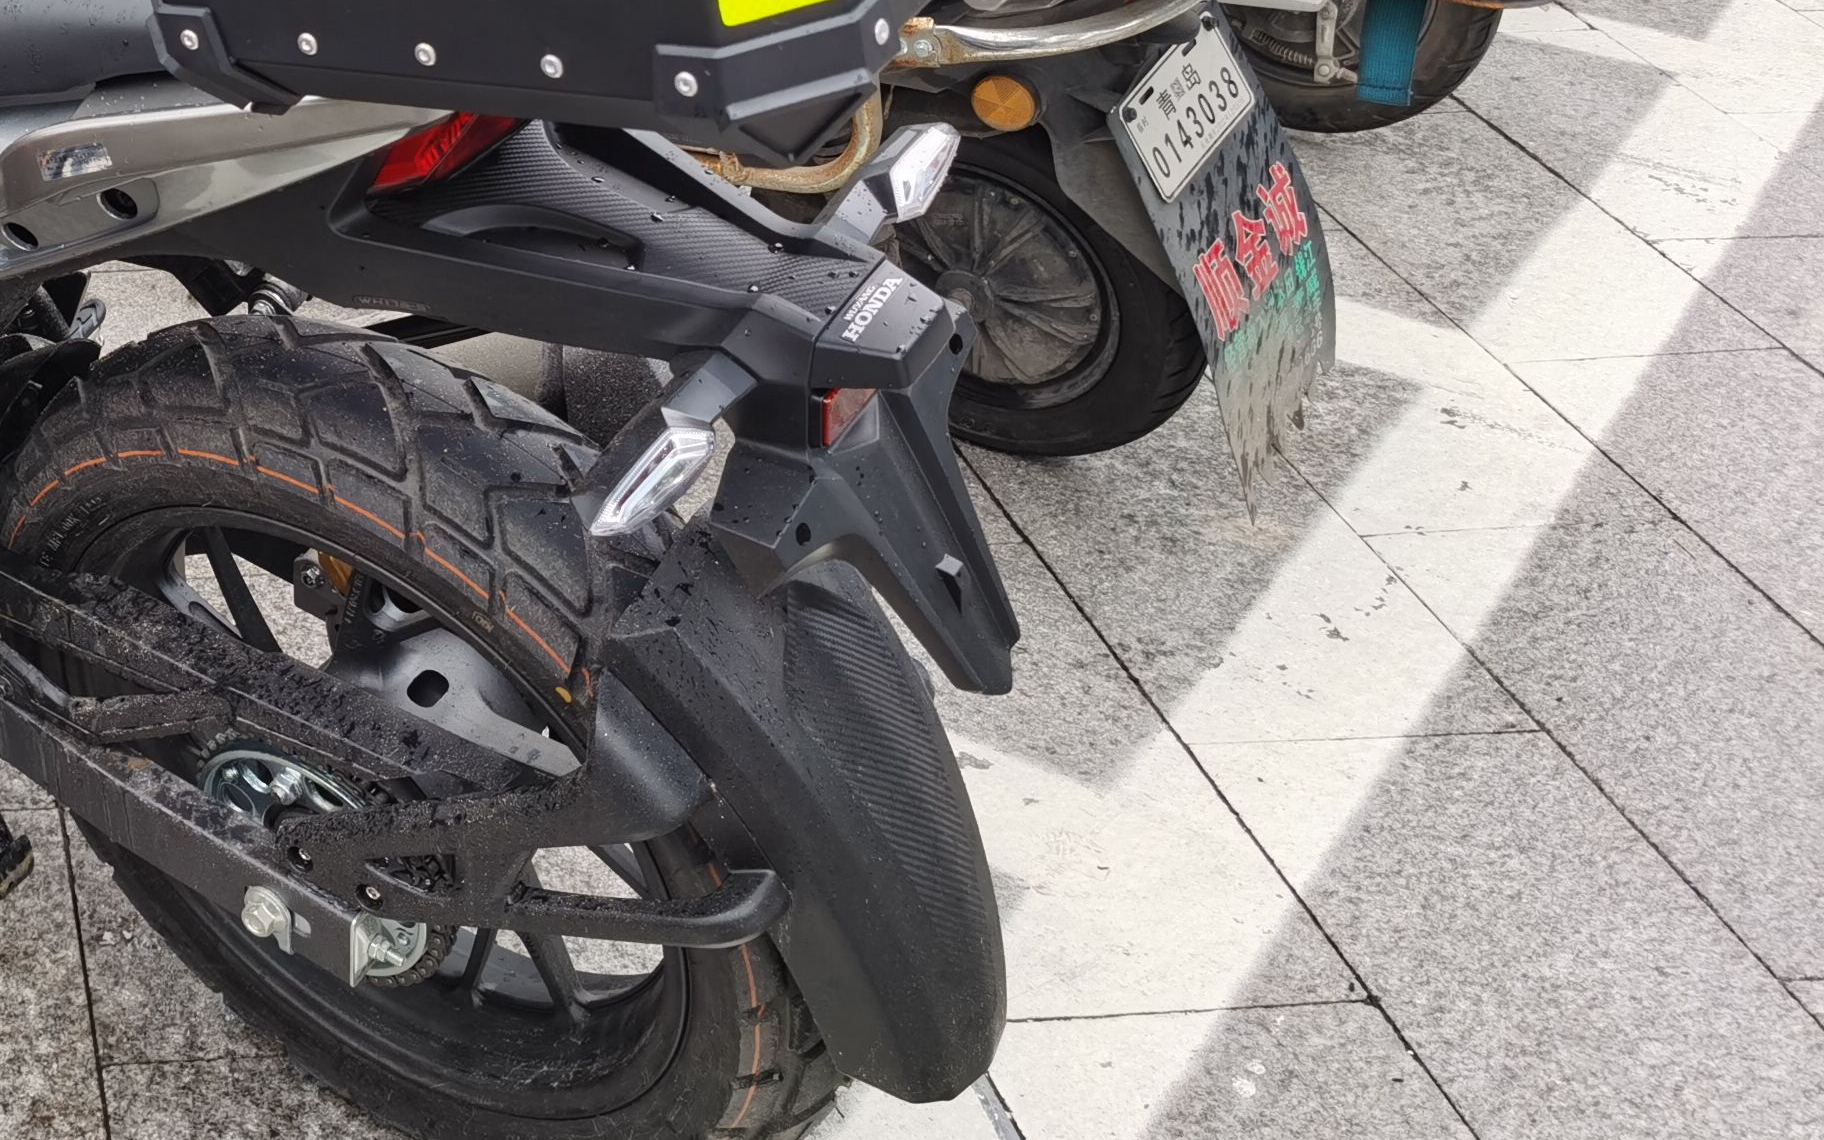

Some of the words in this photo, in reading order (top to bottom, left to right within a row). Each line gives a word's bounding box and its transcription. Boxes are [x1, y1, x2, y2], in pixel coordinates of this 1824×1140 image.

[1152, 67, 1239, 178] 0143038
[1192, 161, 1308, 341] 顺金诚
[841, 277, 903, 342] HONDA
[843, 284, 878, 321] WUYANG
